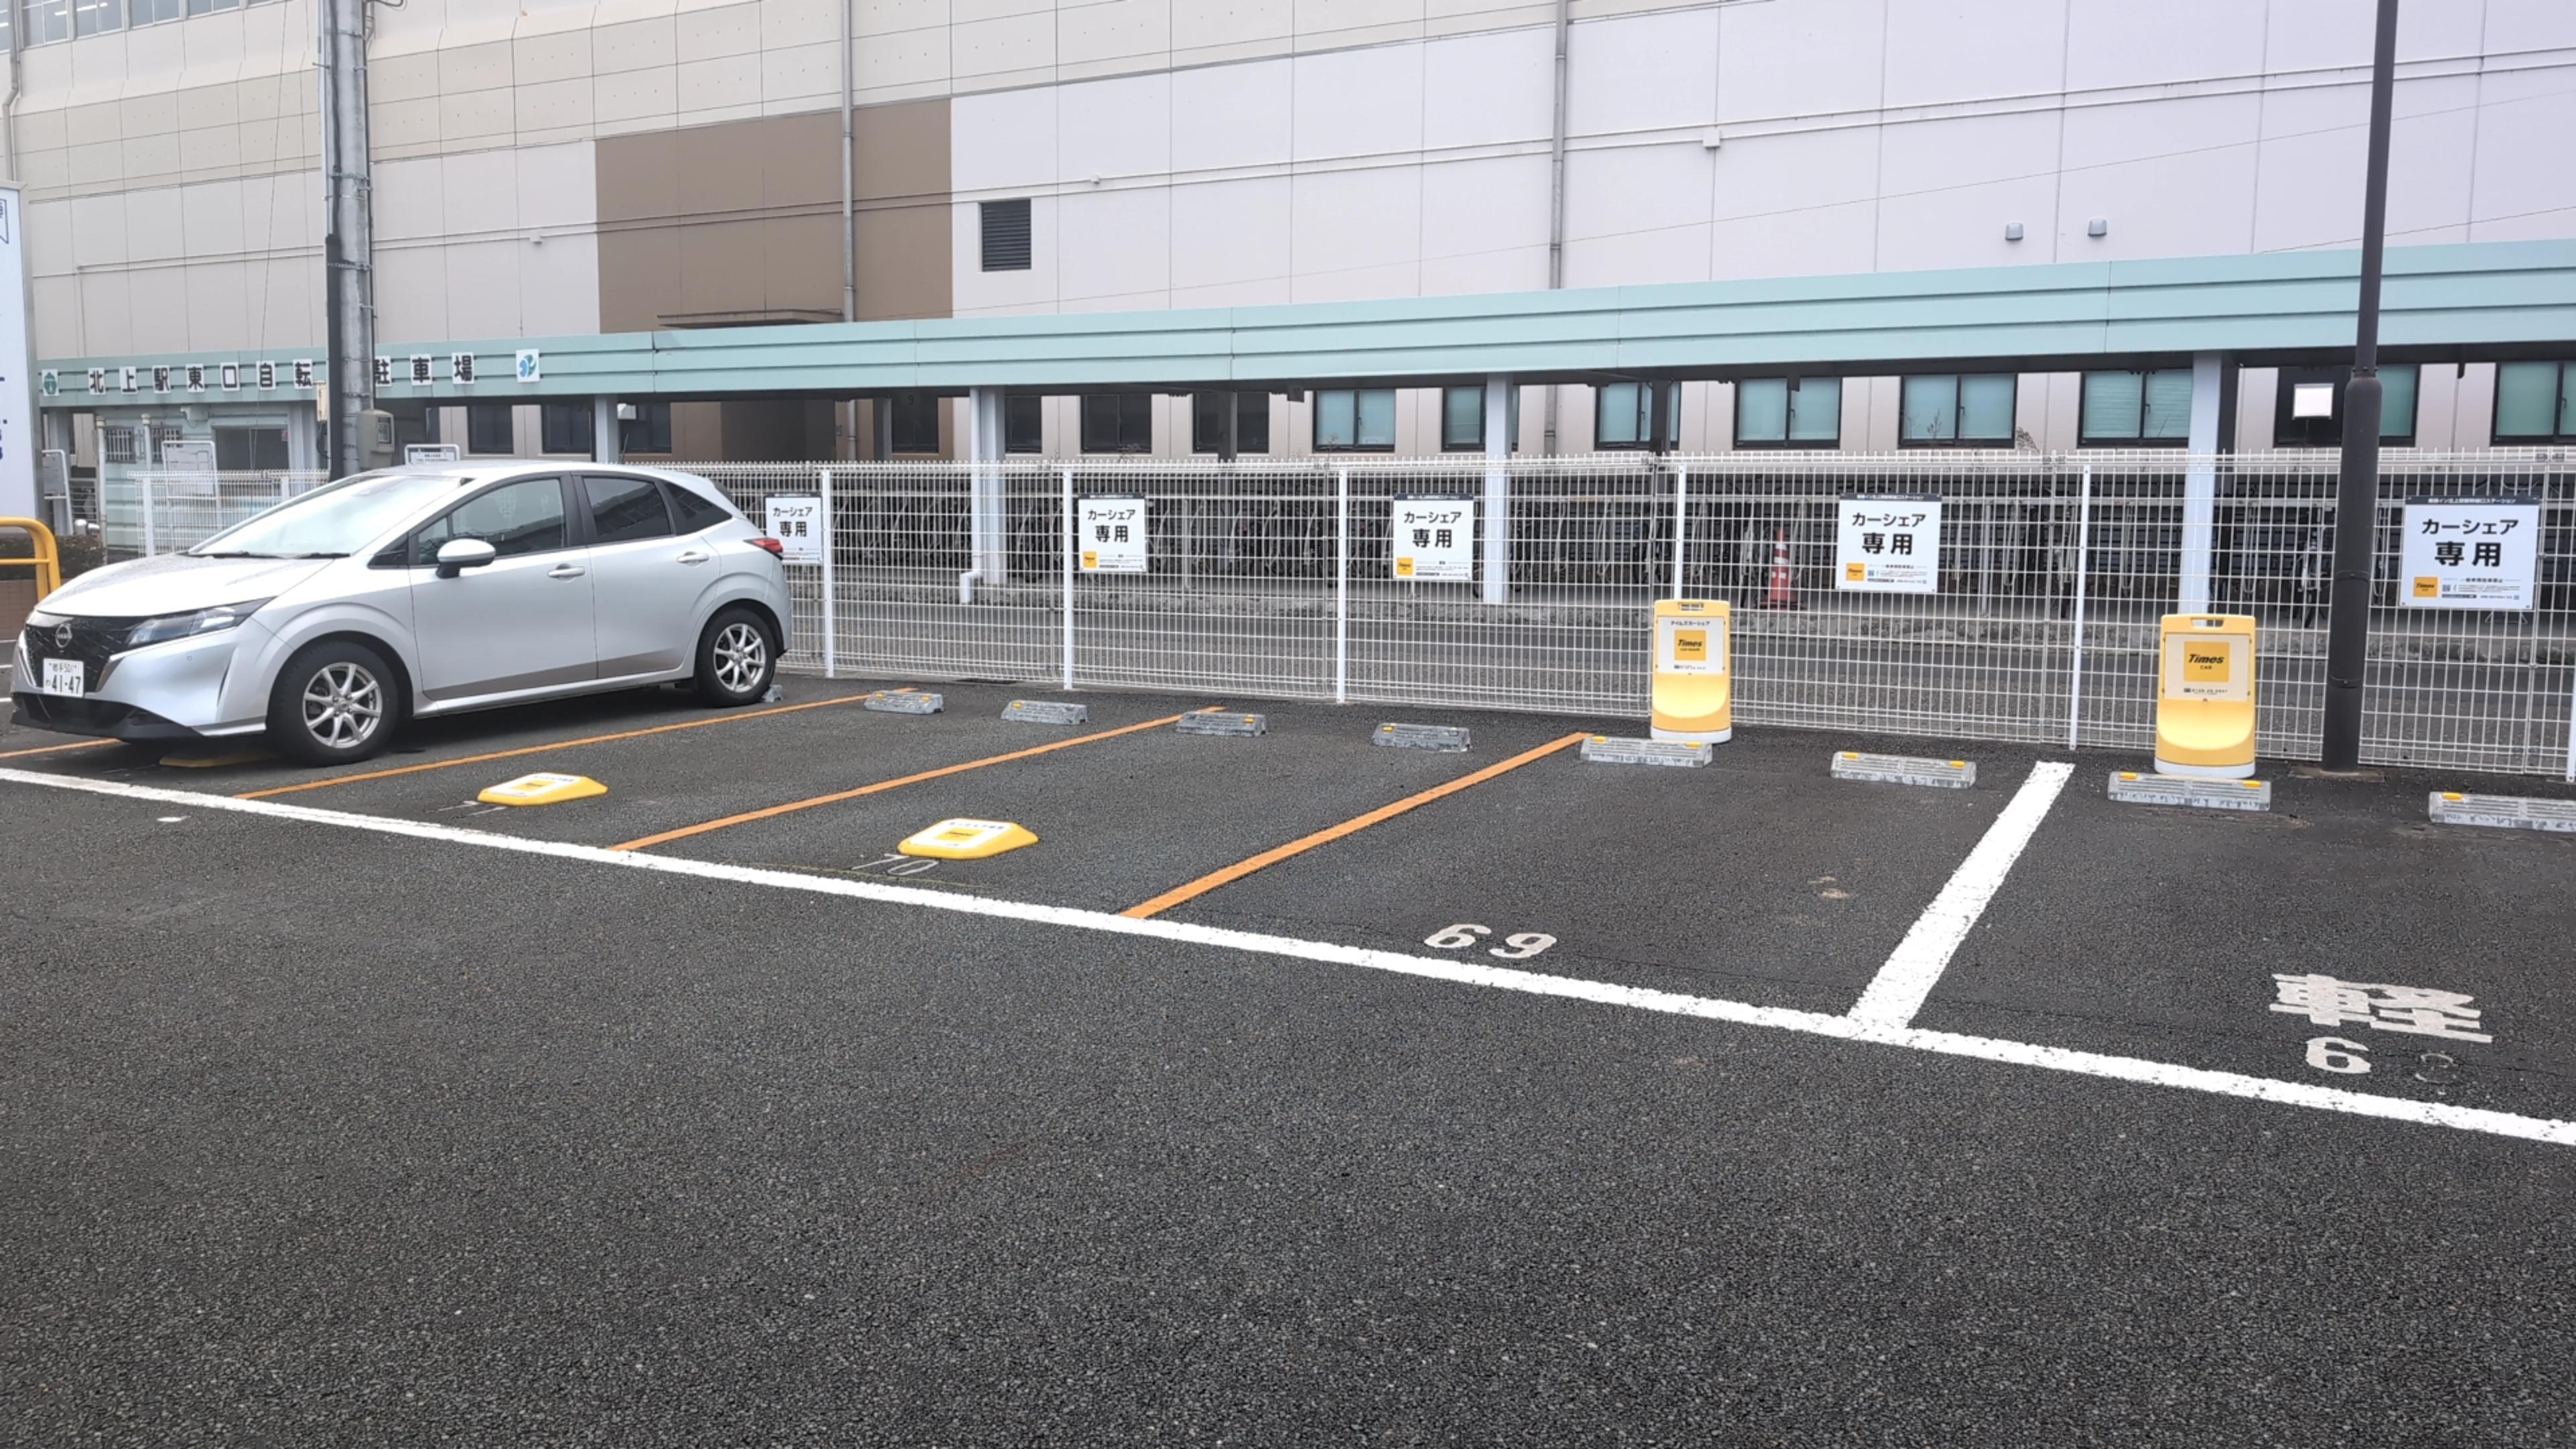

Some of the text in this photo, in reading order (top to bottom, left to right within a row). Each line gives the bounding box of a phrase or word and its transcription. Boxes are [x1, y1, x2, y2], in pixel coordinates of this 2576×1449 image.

[89, 355, 473, 394] 北上駅東口自転駐車場
[773, 506, 813, 517] カーシェア
[1087, 508, 1136, 520] カーシェア
[1404, 511, 1462, 523] カーシェア
[1852, 512, 1926, 527] カーシェア
[779, 521, 807, 537] 専用
[1095, 525, 1128, 543] 専用
[2421, 519, 2519, 535] カーシェア
[1412, 528, 1452, 548] 専用
[1862, 532, 1913, 555] 専用
[2434, 541, 2502, 567] 専用
[1678, 639, 1703, 647] Times
[2188, 653, 2225, 663] Times
[1424, 924, 1557, 959] 69
